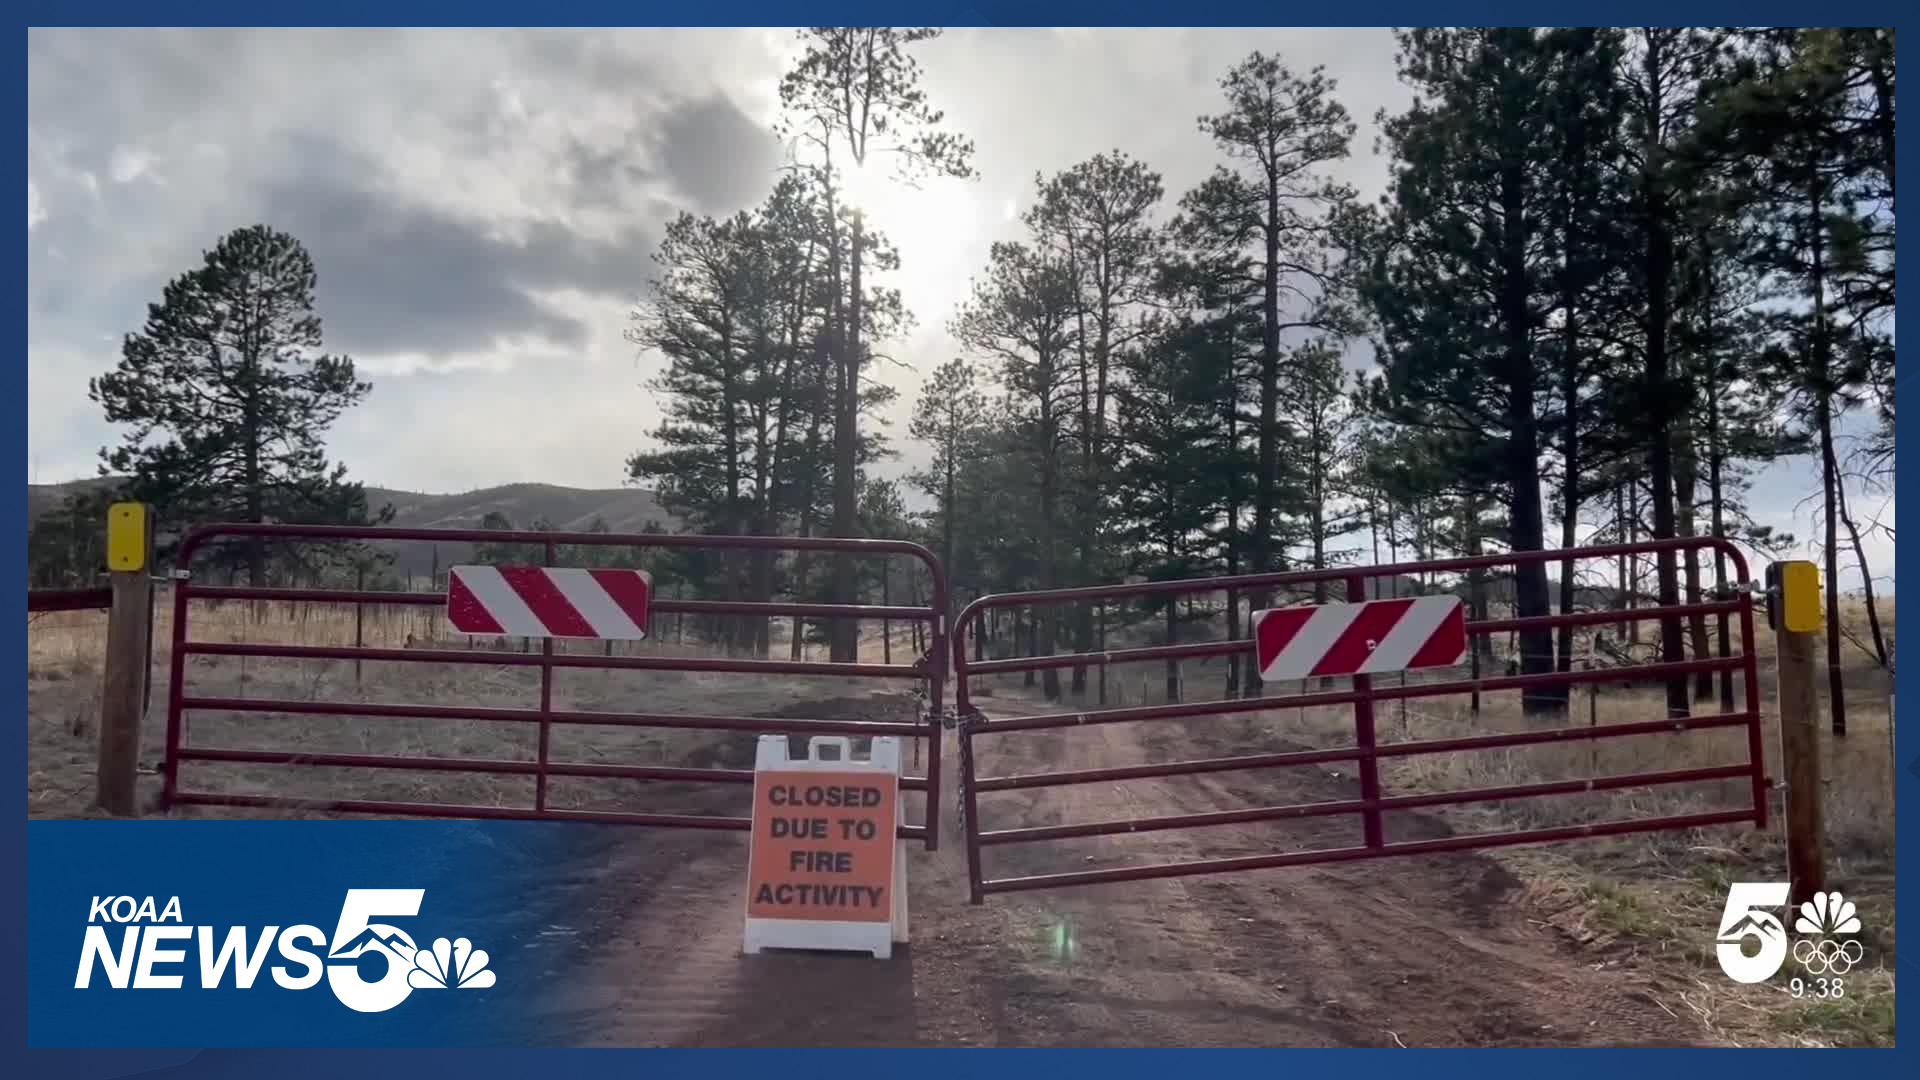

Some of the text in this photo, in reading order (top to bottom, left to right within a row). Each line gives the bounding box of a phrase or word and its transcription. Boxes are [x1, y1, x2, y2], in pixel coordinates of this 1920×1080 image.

[768, 785, 881, 807] CLOSED
[770, 818, 876, 840] DUE TO
[789, 851, 853, 873] FIRE
[755, 883, 883, 907] ACTIVITY
